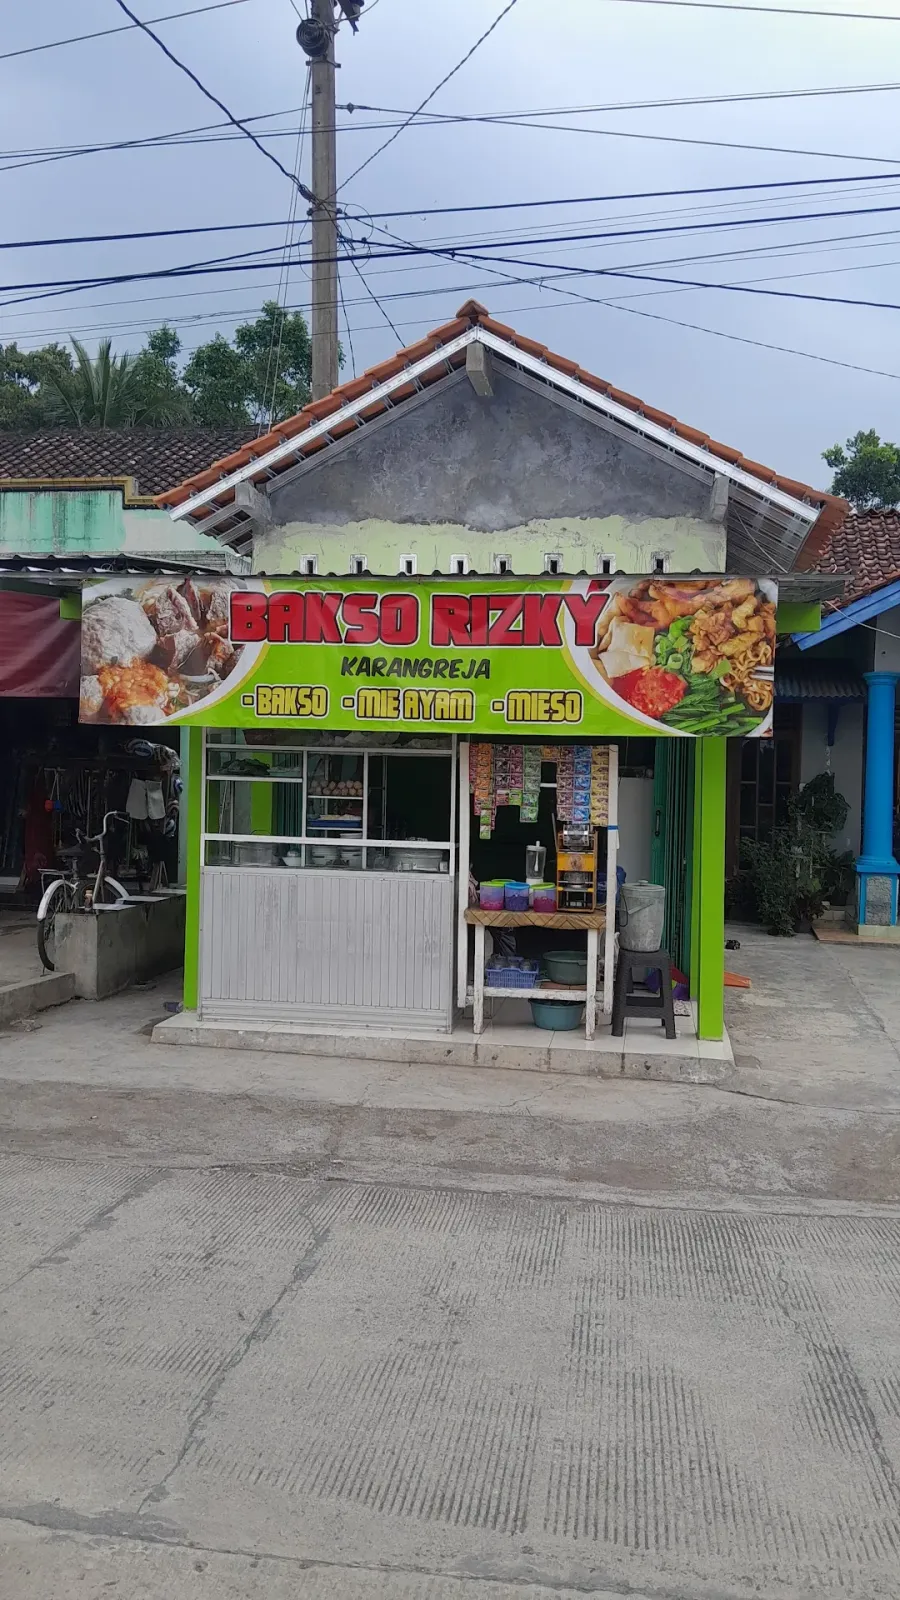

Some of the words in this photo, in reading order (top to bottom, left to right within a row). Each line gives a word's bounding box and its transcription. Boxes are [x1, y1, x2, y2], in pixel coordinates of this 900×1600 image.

[229, 590, 421, 645] BAKSO
[431, 593, 610, 647] RIZKY
[341, 656, 491, 680] KARANGREJA
[402, 688, 475, 721] AYAM
